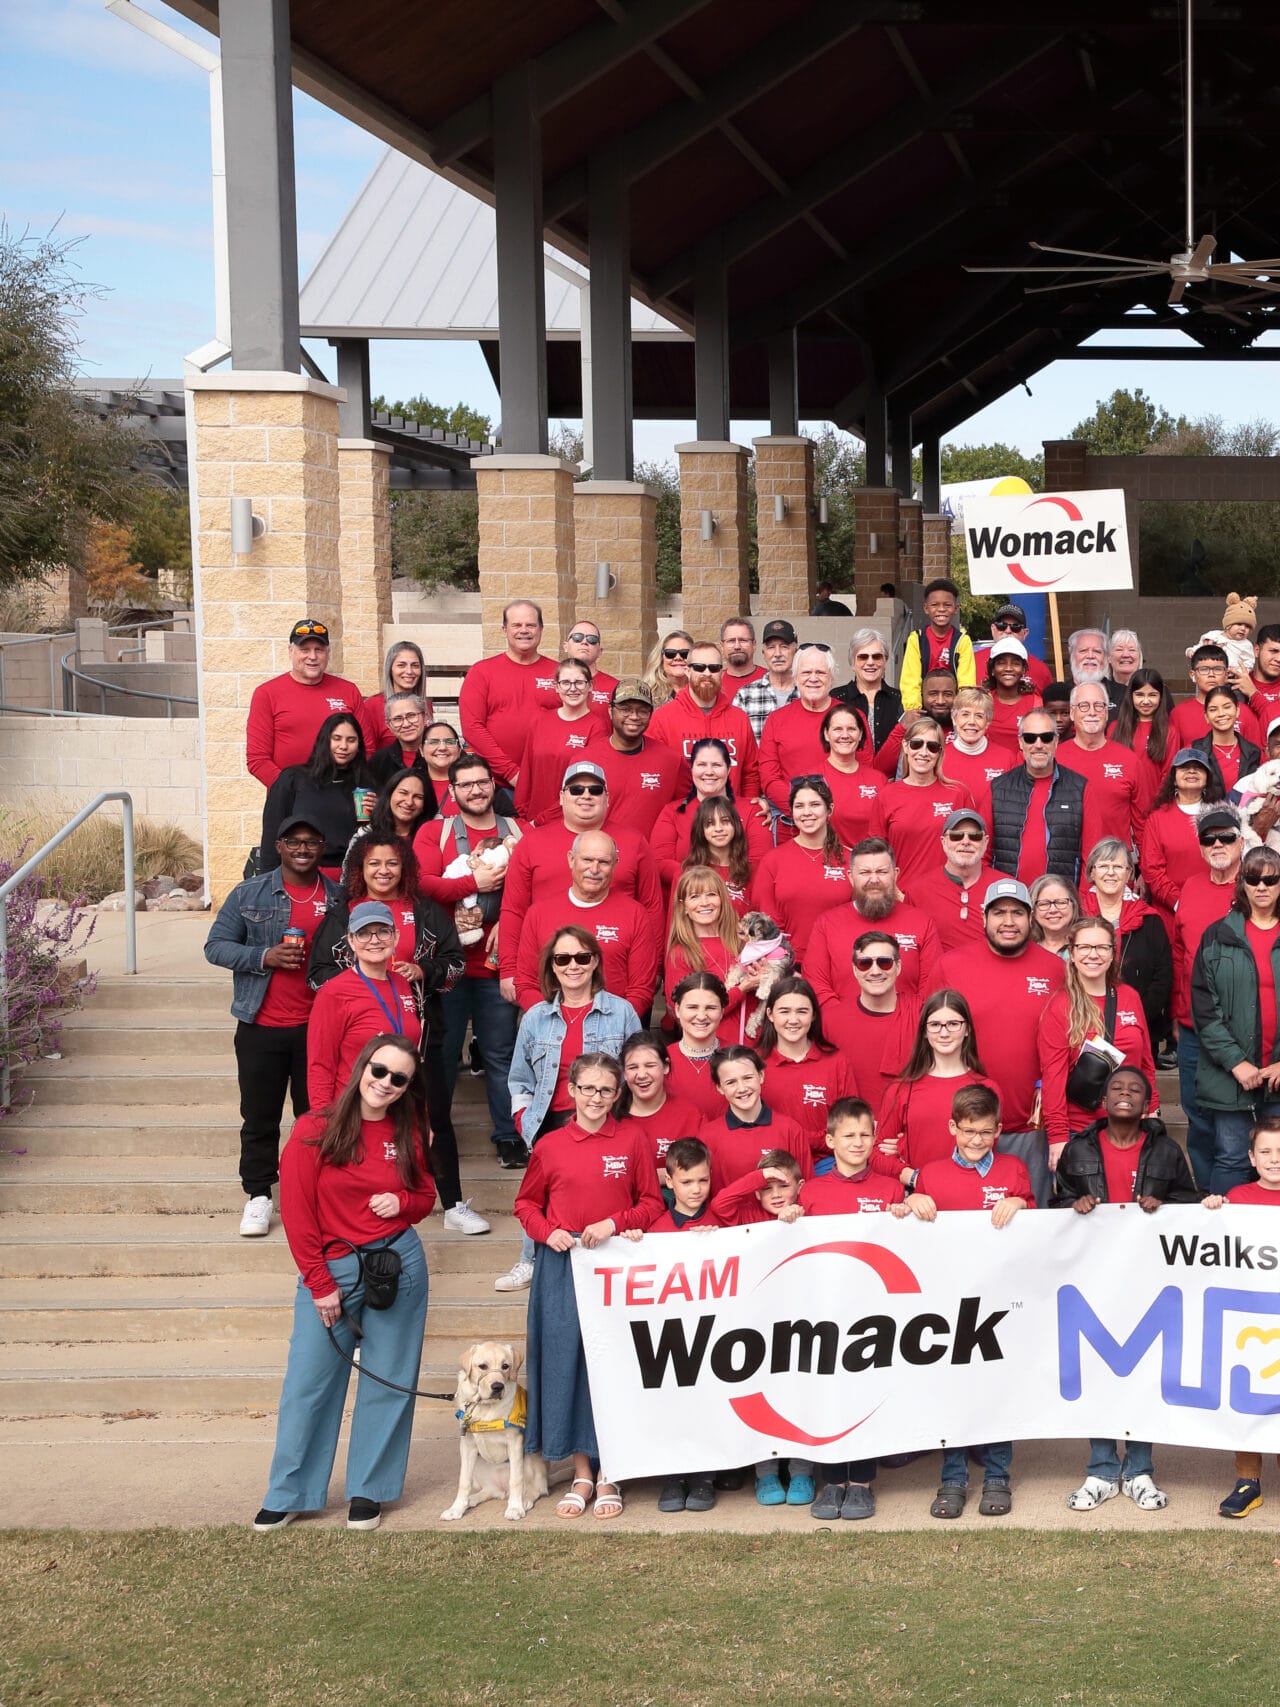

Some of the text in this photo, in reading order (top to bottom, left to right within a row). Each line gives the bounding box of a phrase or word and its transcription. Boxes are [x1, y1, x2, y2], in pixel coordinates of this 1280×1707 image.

[968, 521, 1117, 559] Womack
[1160, 1234, 1280, 1271] Walks
[594, 1255, 740, 1307] TEAM
[630, 1297, 1009, 1389] Womack
